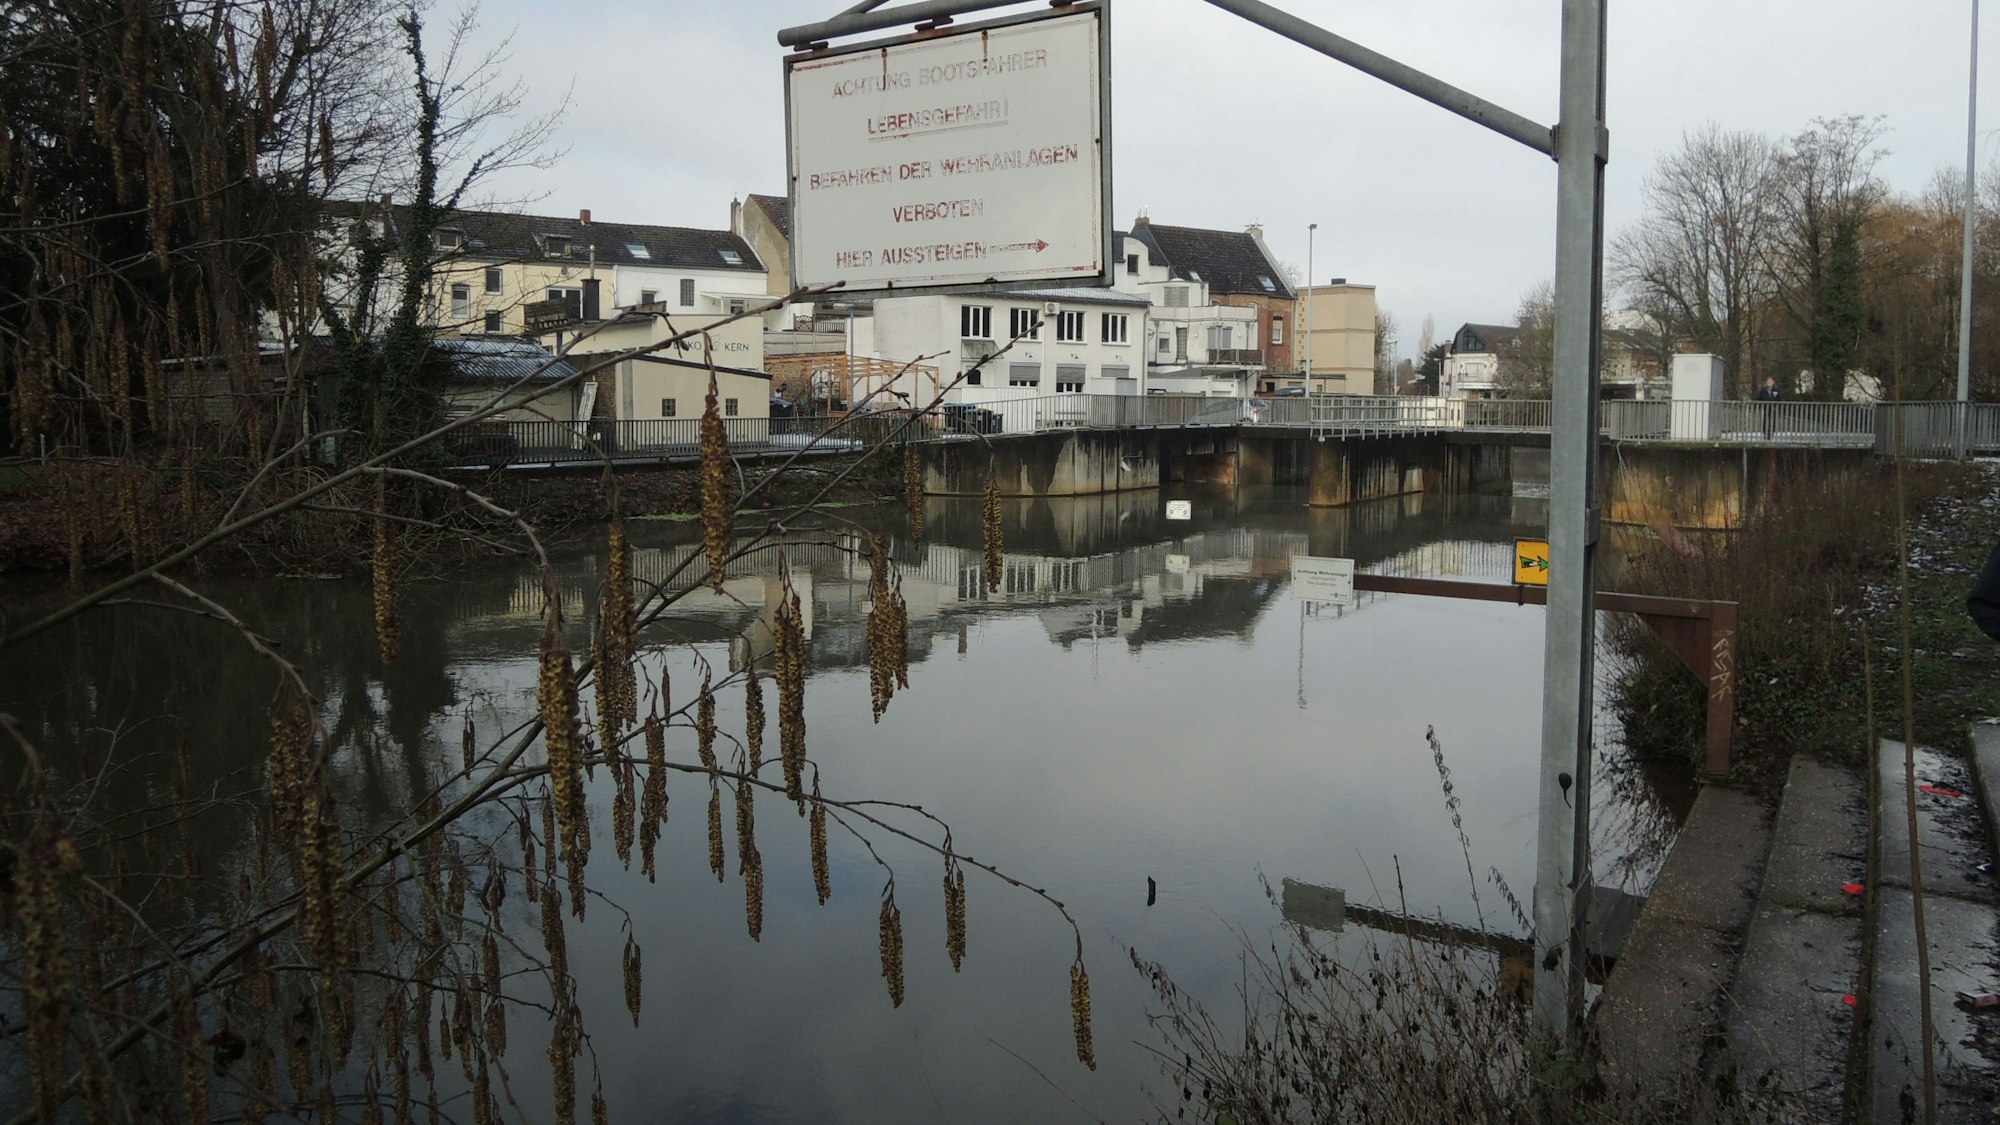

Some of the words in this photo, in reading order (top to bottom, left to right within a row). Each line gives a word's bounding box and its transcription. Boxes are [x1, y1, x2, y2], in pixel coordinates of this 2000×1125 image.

[833, 71, 911, 98] ACHTUNG
[919, 49, 1048, 87] BOOTSFAHRER
[810, 165, 892, 191] BEFAHREN
[900, 161, 932, 181] DER
[939, 144, 1078, 177] WEHRANLAGEN
[893, 198, 984, 223] VERBOTEN
[836, 250, 873, 269] HIER
[881, 241, 987, 267] AUSSTEIGEN
[724, 342, 749, 352] KERN
